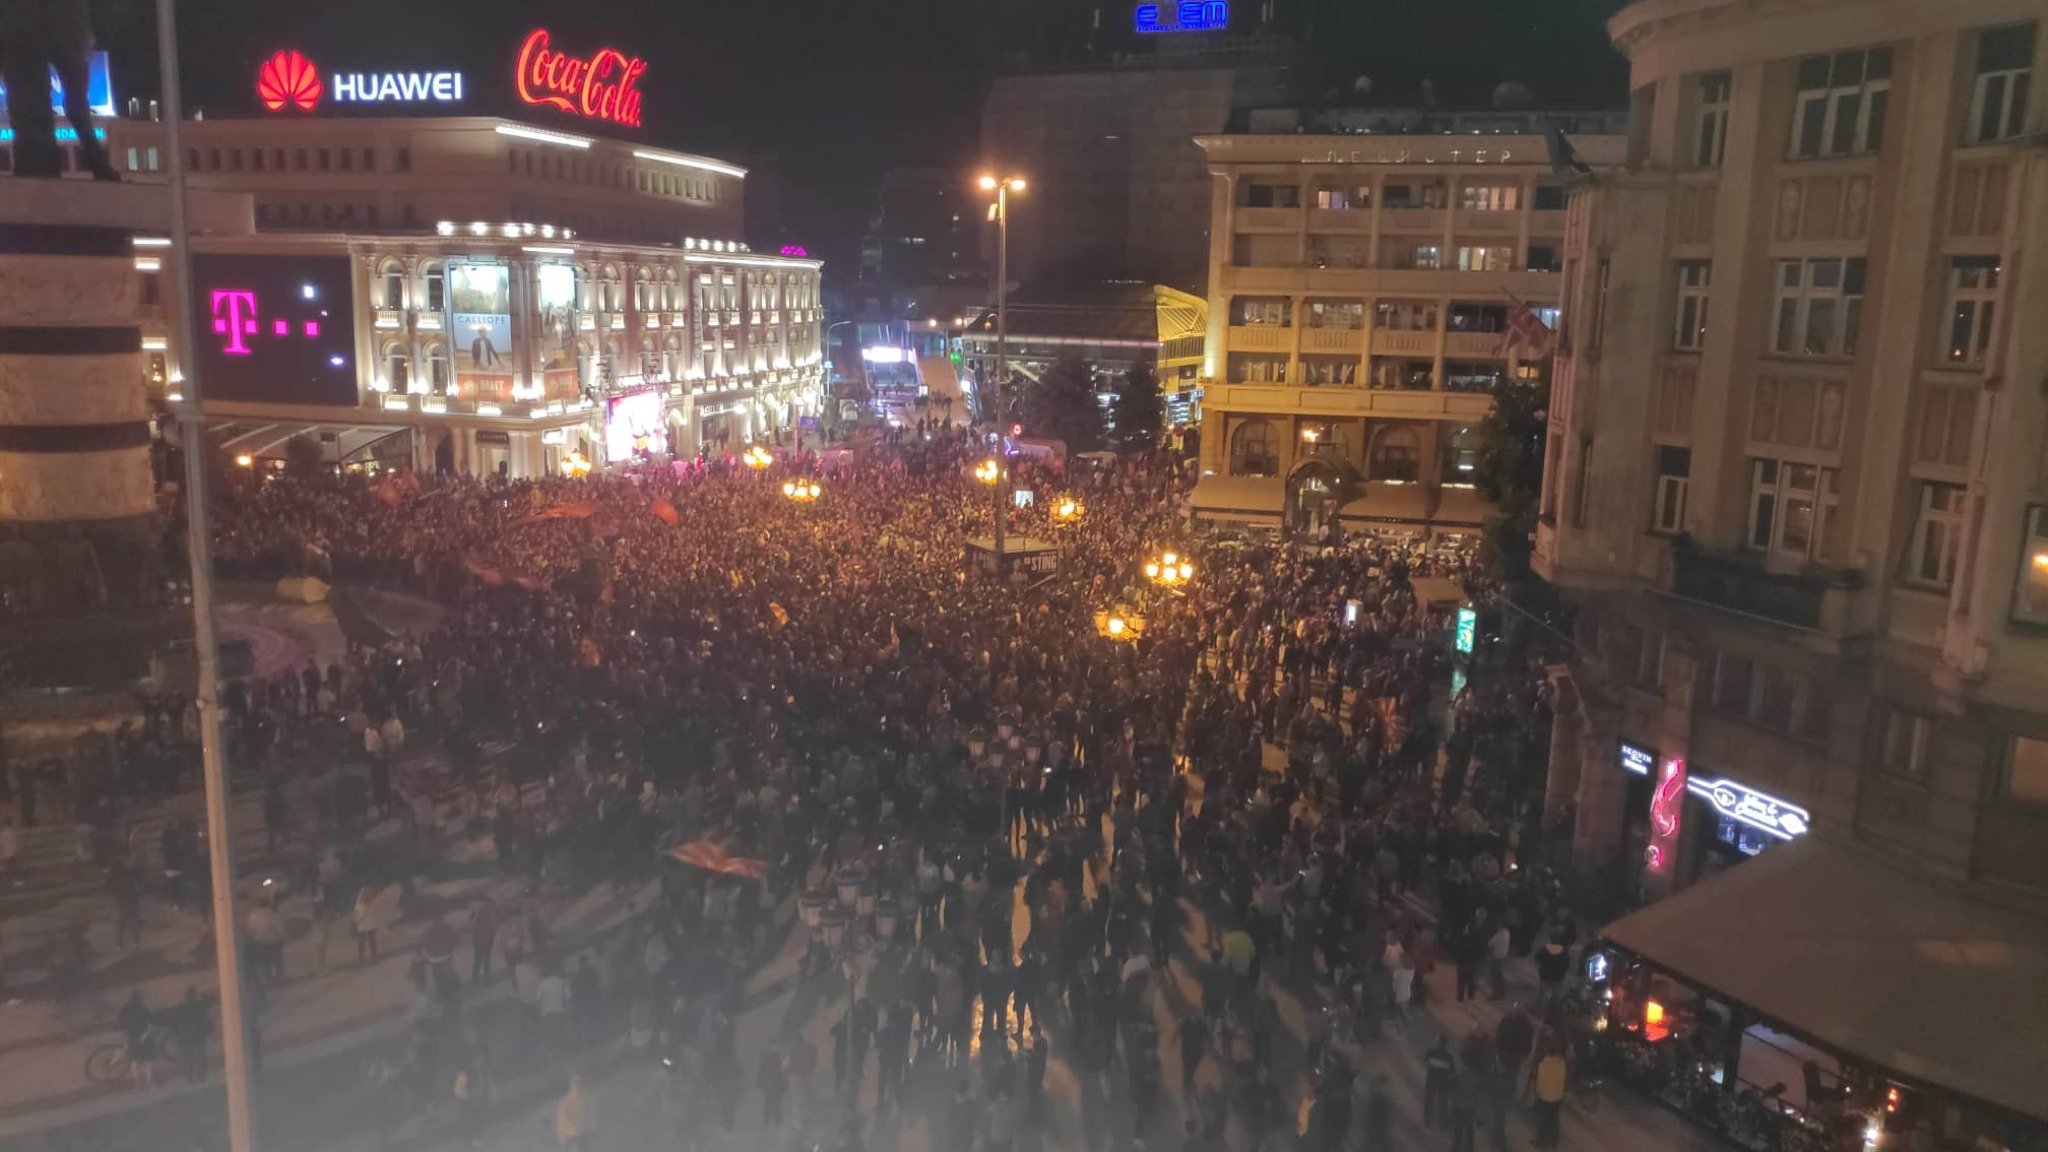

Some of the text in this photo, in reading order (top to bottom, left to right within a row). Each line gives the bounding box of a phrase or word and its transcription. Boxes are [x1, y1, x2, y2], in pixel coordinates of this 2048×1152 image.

[1137, 2, 1227, 25] EEM
[334, 72, 462, 101] HUAWEI
[515, 28, 646, 127] Coca-Cola
[1031, 554, 1057, 571] STING
